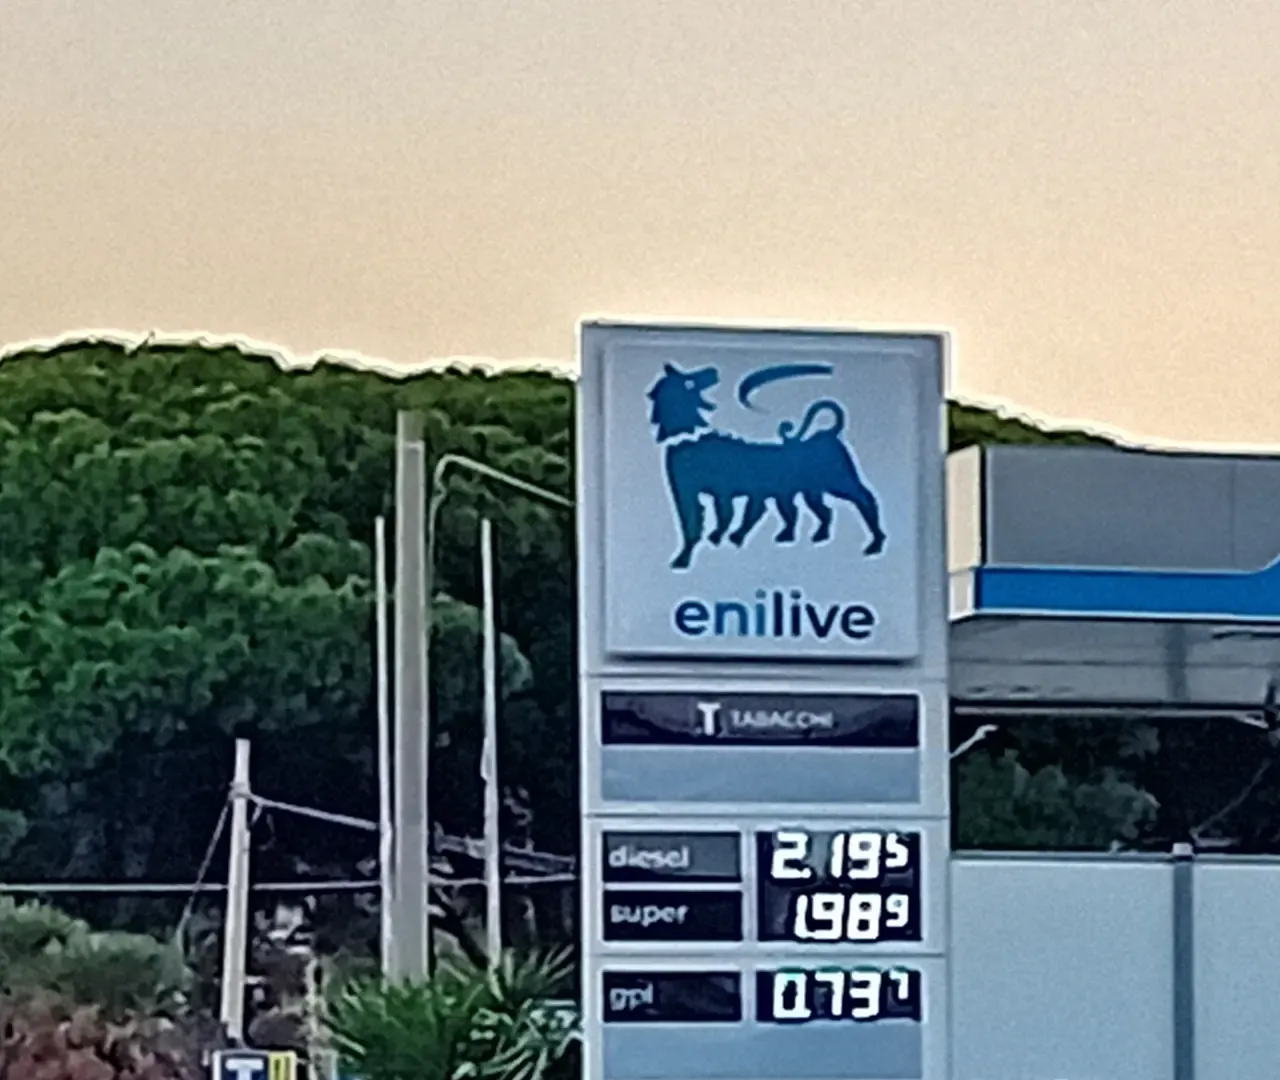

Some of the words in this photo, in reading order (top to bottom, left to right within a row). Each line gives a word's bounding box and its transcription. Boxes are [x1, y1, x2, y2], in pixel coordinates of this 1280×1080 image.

[674, 589, 875, 639] enilive
[608, 845, 690, 868] diesel
[610, 904, 690, 928] super
[609, 981, 654, 1011] gpl
